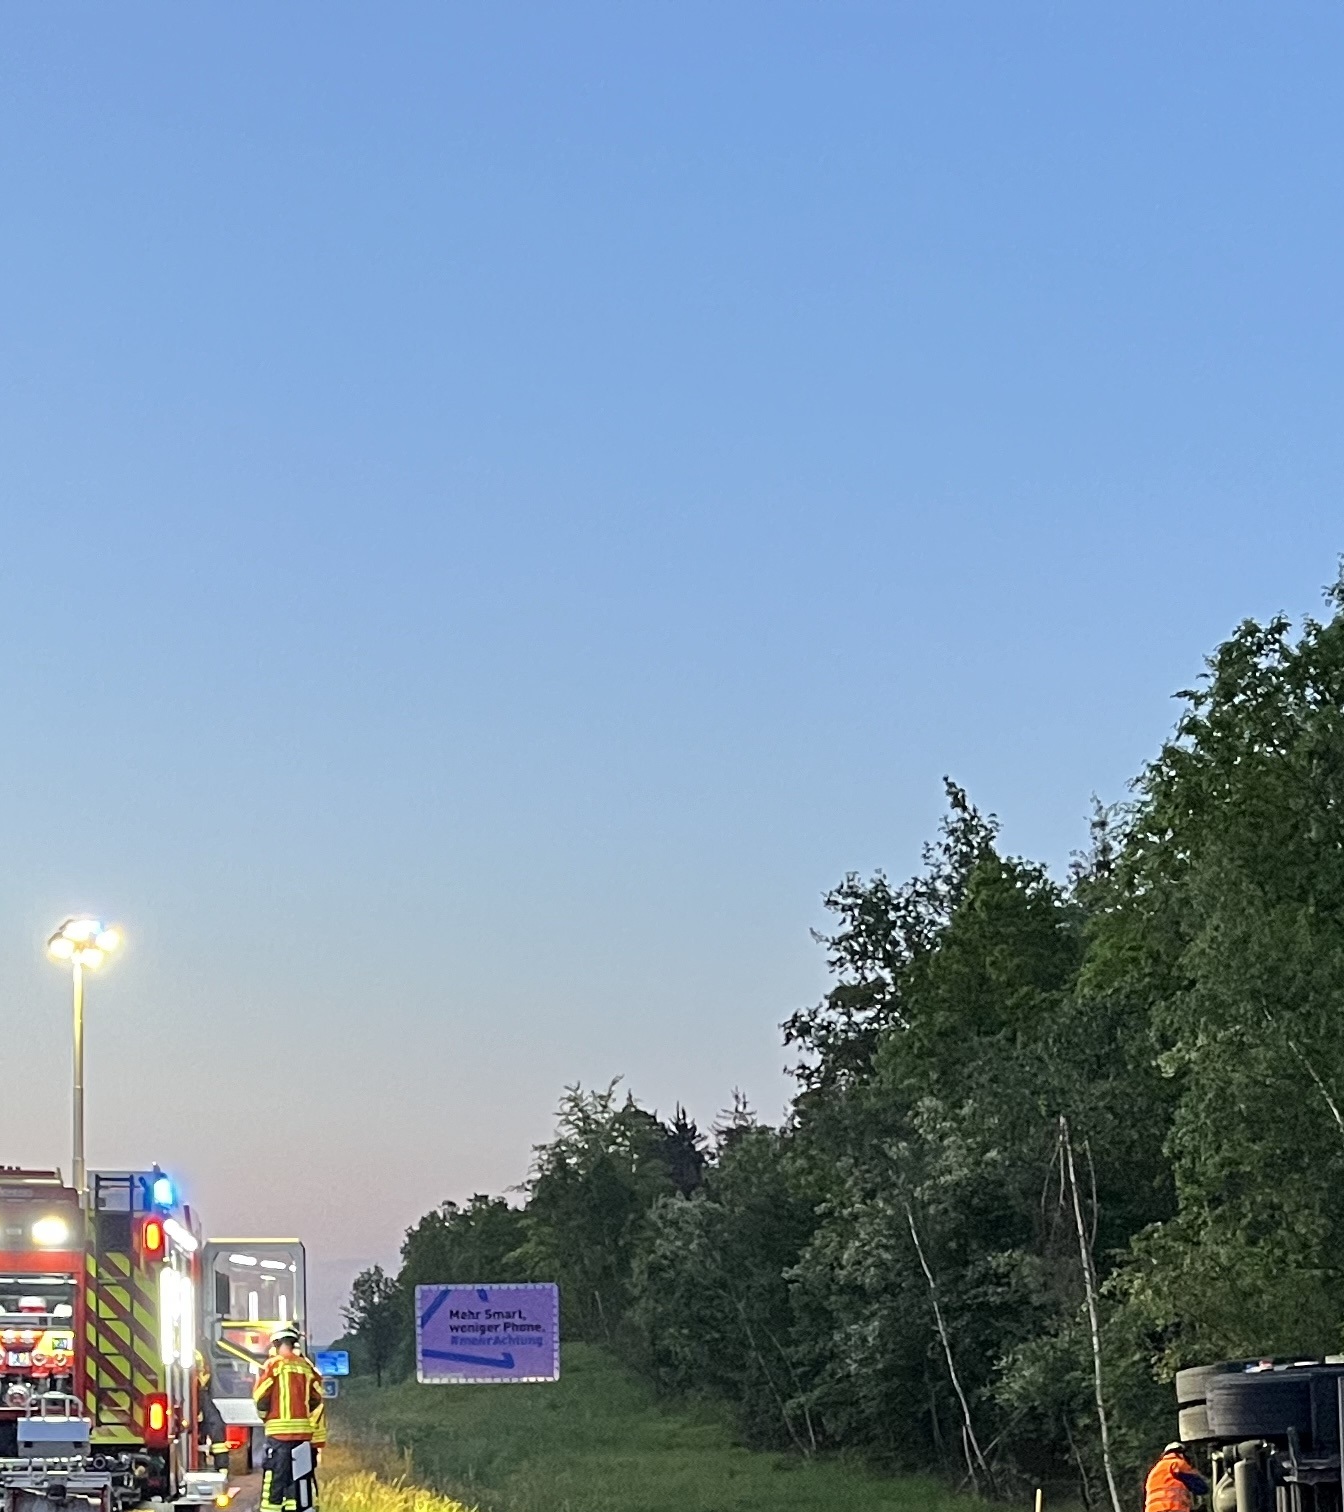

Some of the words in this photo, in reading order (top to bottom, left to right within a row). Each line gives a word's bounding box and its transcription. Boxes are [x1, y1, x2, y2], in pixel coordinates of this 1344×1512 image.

[449, 1309, 481, 1319] Mehr
[449, 1322, 500, 1336] weniger
[503, 1322, 546, 1333] Phone.
